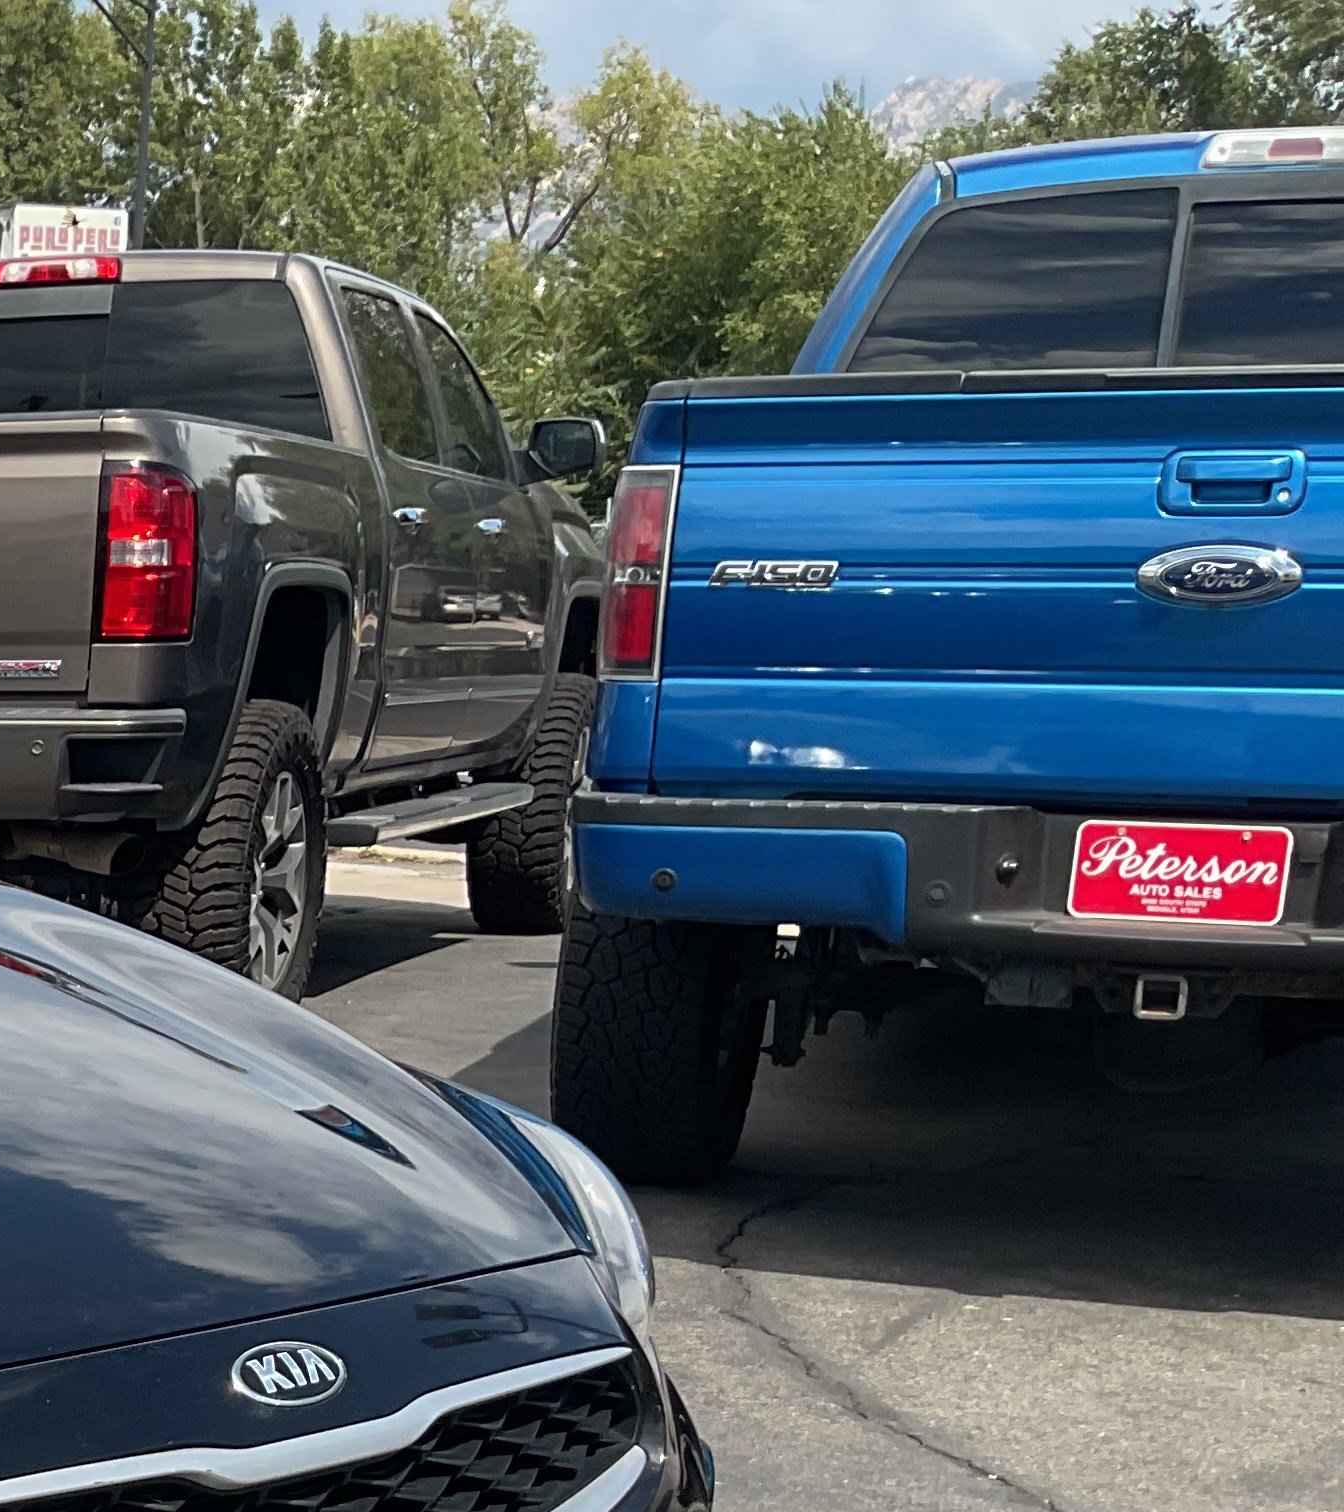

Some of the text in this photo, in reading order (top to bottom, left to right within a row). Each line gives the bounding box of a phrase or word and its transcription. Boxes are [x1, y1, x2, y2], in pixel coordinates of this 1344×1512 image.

[19, 225, 121, 253] PURO PERU
[1183, 561, 1255, 589] Ford
[1080, 835, 1279, 886] Peterson
[1129, 884, 1223, 900] AUTO SALES
[245, 1348, 336, 1394] KIA
